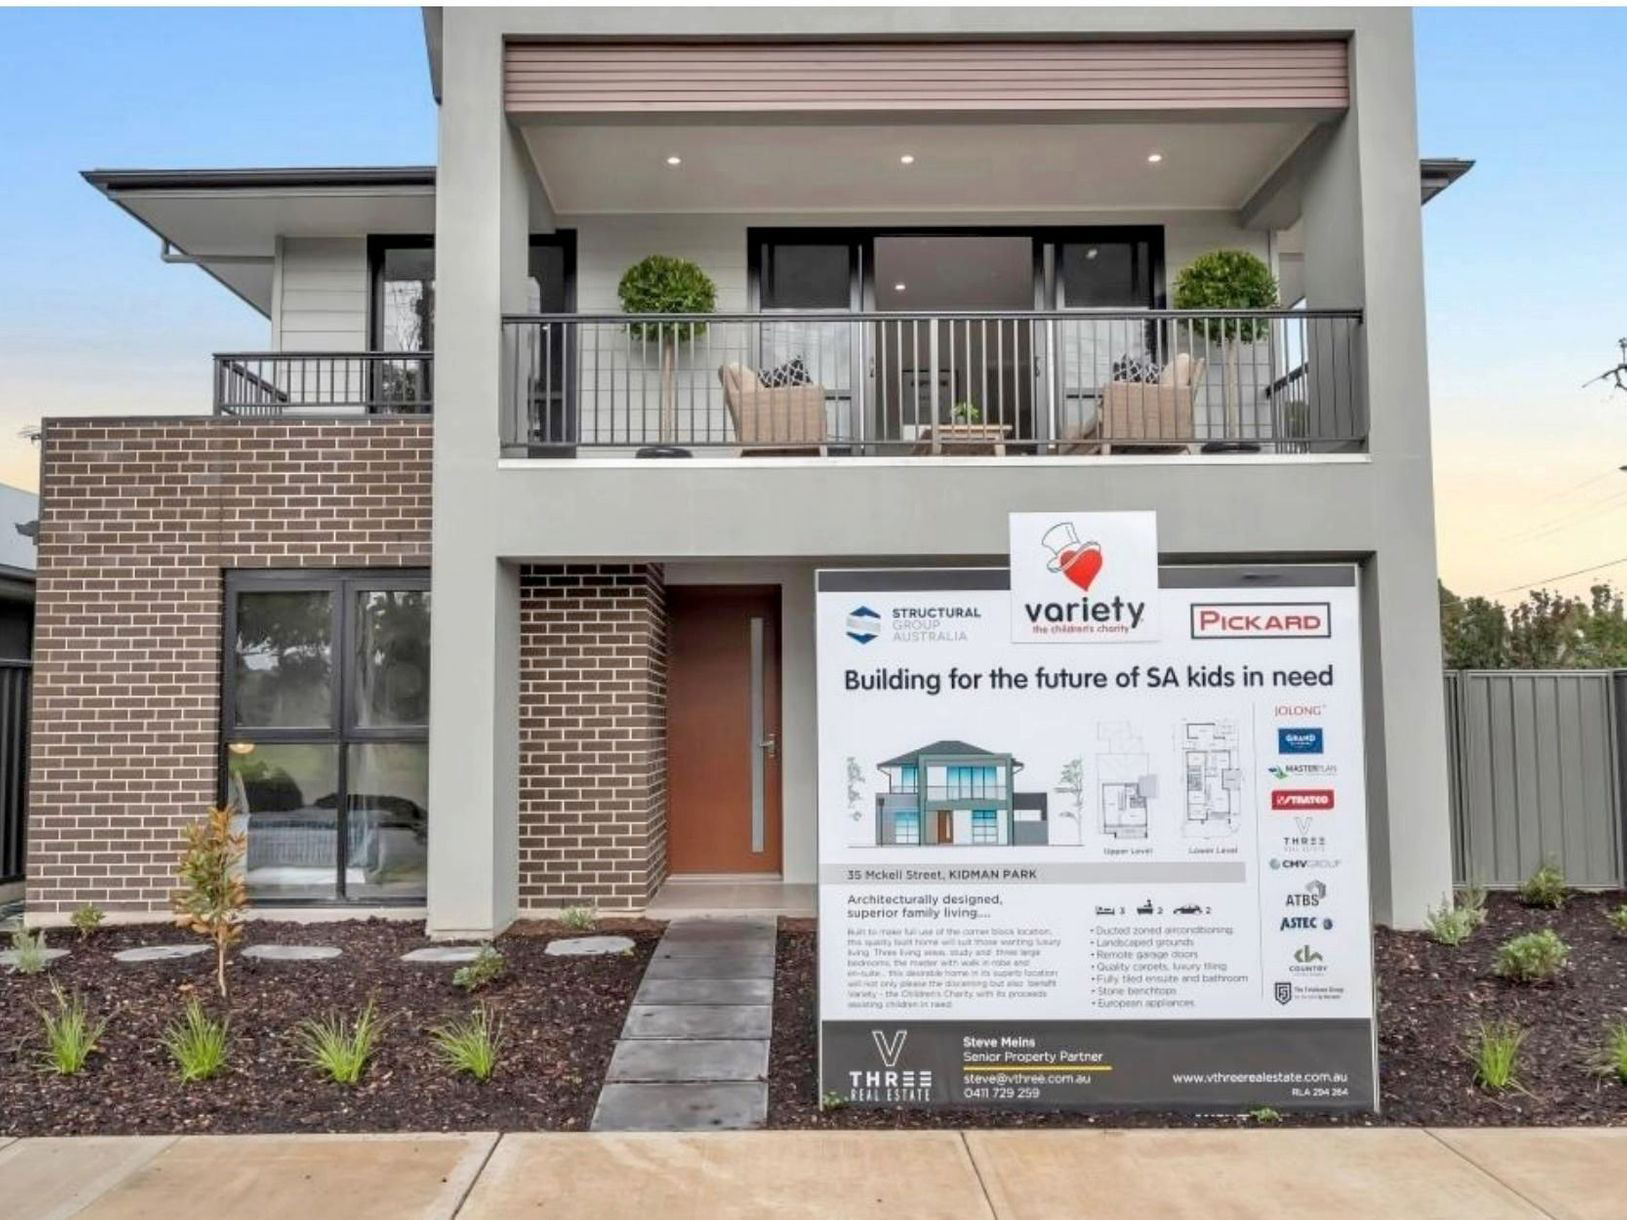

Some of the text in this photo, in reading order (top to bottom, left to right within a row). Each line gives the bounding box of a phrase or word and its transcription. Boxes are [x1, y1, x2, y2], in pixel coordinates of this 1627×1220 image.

[892, 608, 981, 618] STRUCTURAL
[1025, 596, 1145, 628] variety
[893, 619, 941, 630] GROUP
[1033, 625, 1049, 633] the
[1097, 624, 1129, 633] charity
[893, 632, 967, 642] AUSTRALIA
[845, 664, 1333, 694] Building for the future of SA kids in need
[1274, 705, 1321, 716] JOLONG
[848, 870, 862, 880] 35
[906, 869, 946, 881] Street,
[950, 869, 999, 879] KIDMAN
[1003, 869, 1037, 878] PARK
[848, 893, 1003, 906] Architecturally designed,
[1286, 894, 1319, 906] ATBS
[848, 908, 899, 919] superior
[902, 907, 940, 919] family
[1280, 917, 1317, 931] ASTEC
[872, 1030, 907, 1067] V
[963, 1037, 1035, 1048] Steve Meins
[963, 1051, 1103, 1063] Senior Property Partner
[850, 1071, 932, 1087] THREE
[963, 1073, 1091, 1085] steve@vthree.com.au
[1172, 1072, 1348, 1084] www.vthreerealestate.com.au
[851, 1089, 930, 1101] REAL ESTATE
[964, 1088, 1040, 1099] 0411 729 259
